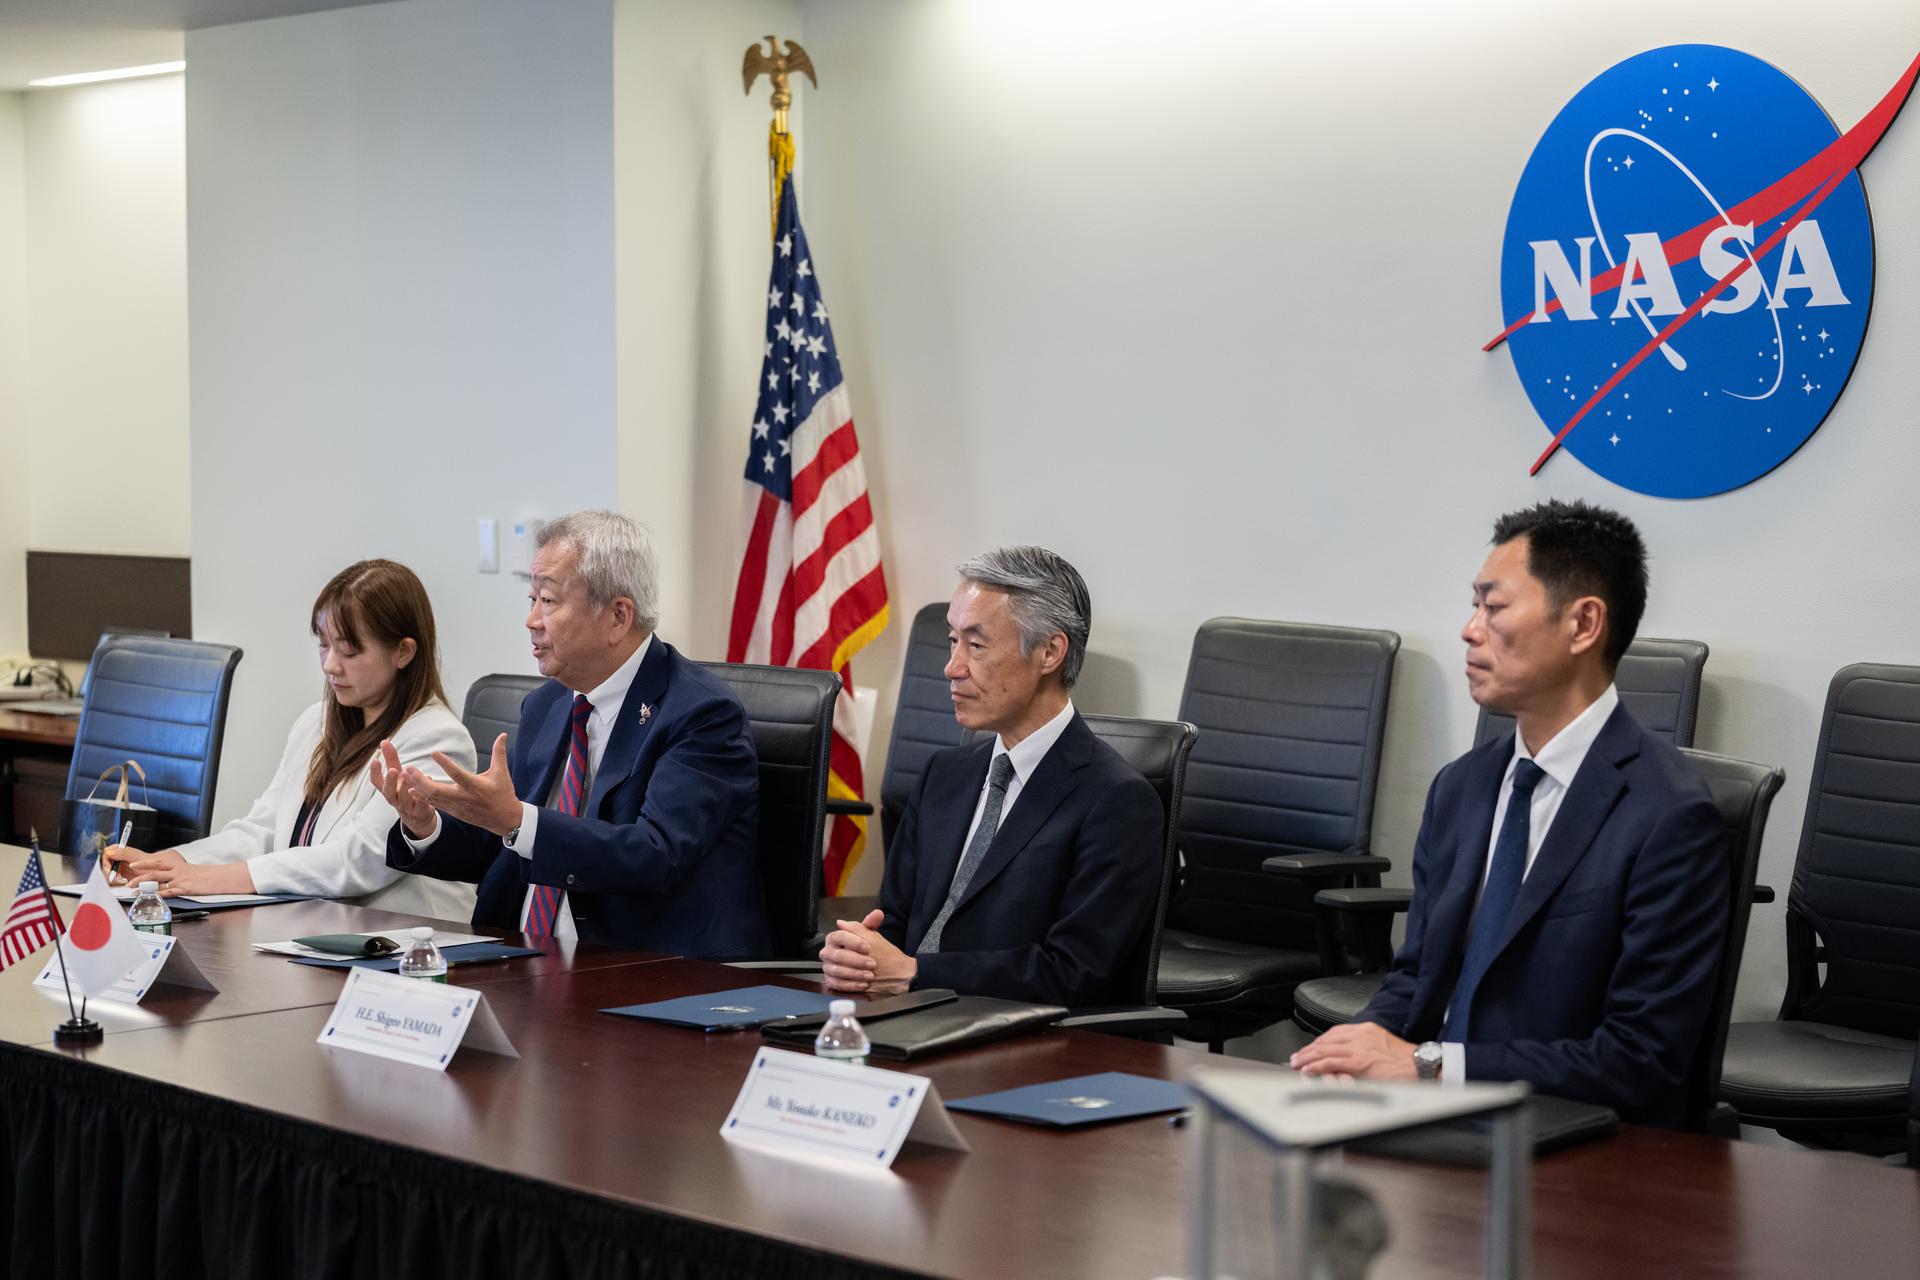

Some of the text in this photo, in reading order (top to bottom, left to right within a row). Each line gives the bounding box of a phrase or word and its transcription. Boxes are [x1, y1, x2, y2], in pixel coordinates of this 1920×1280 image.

[1528, 219, 1851, 324] NASA
[402, 1016, 442, 1038] YAMADA
[822, 1105, 877, 1130] KANEKO
